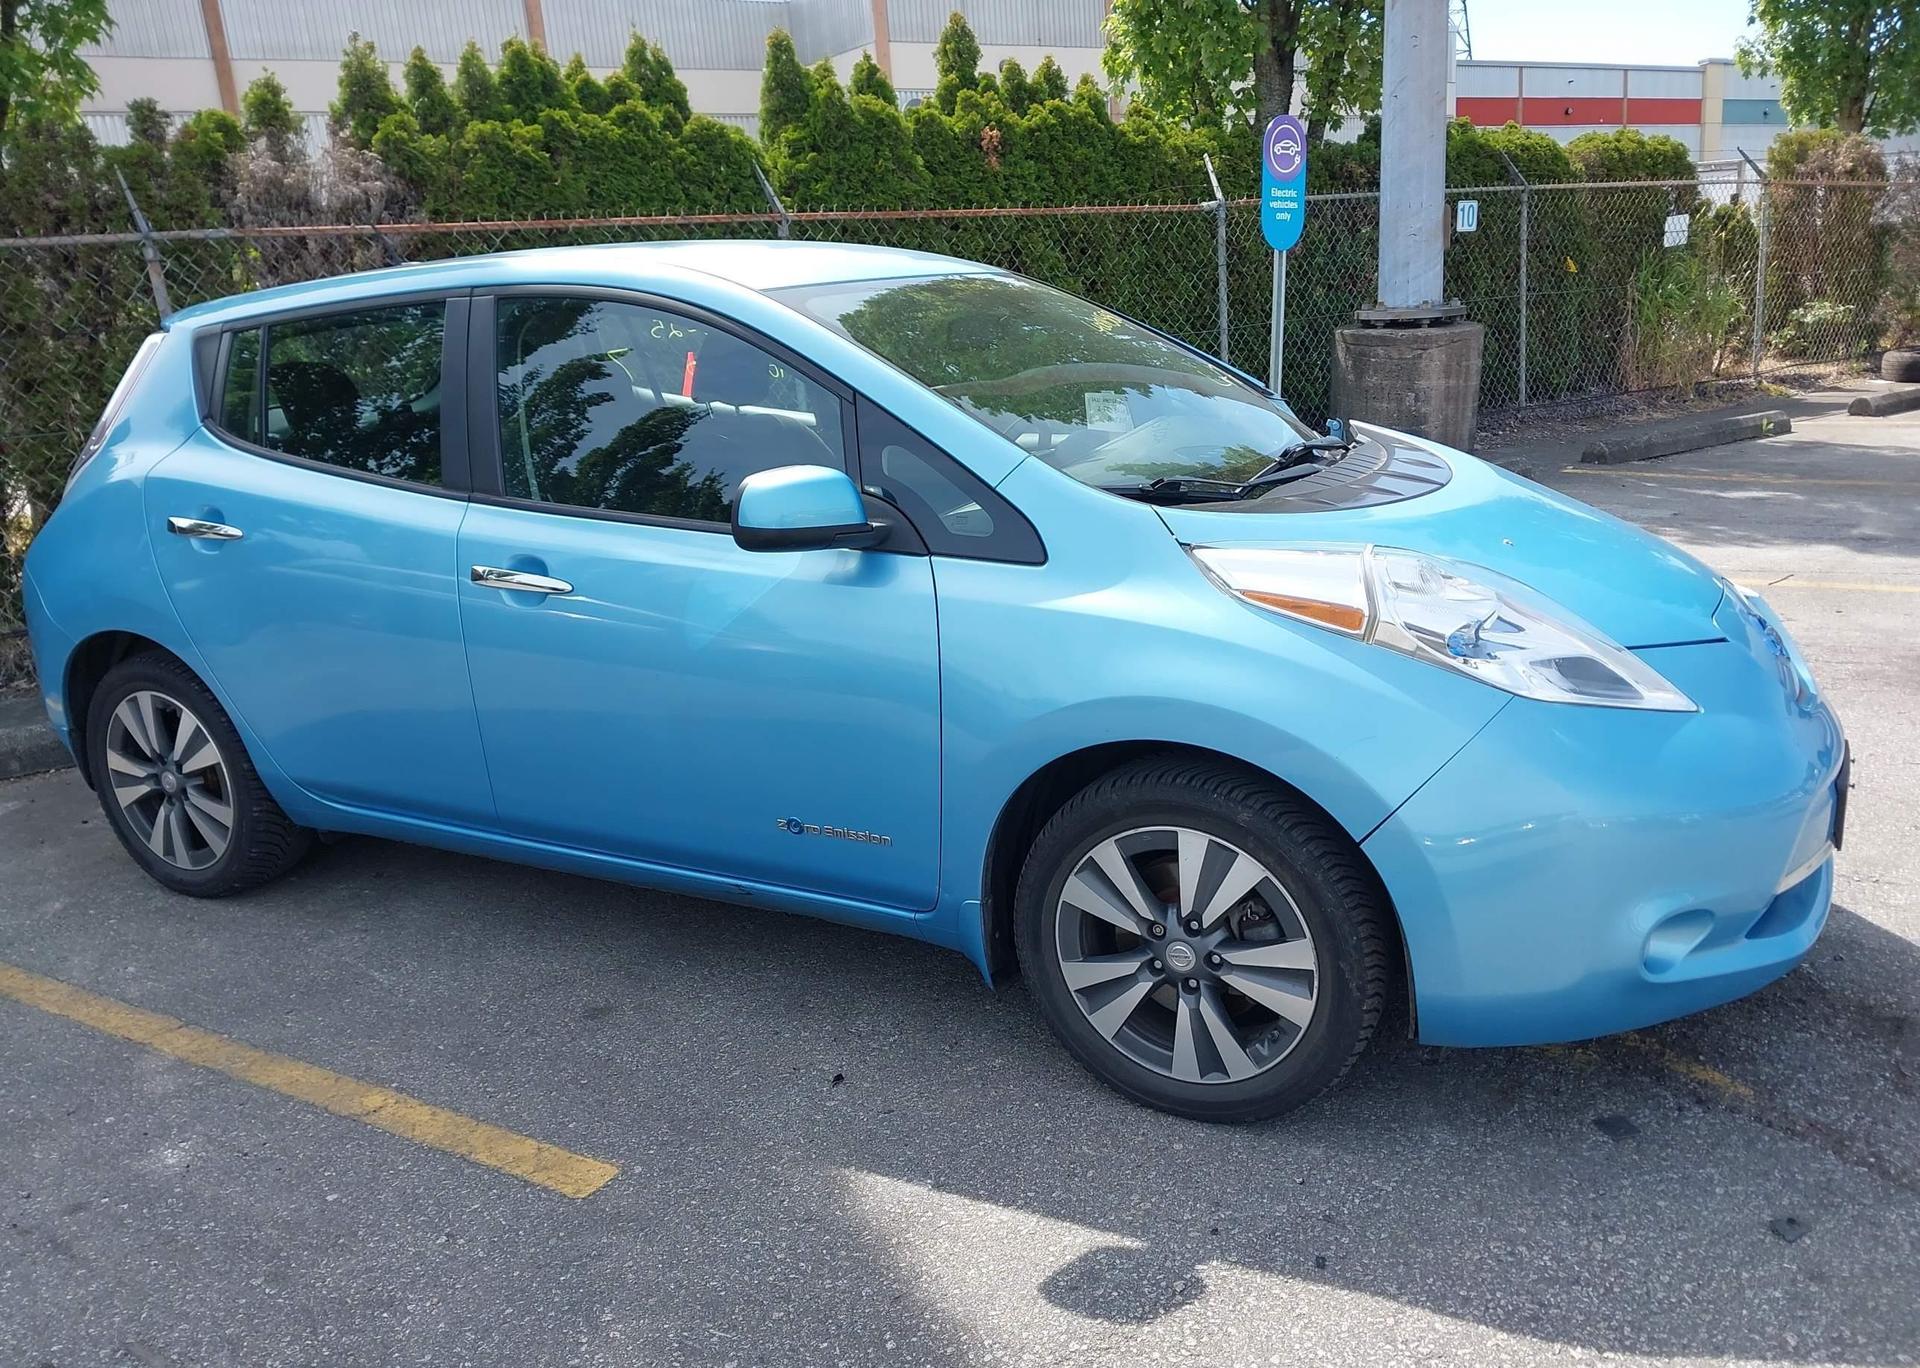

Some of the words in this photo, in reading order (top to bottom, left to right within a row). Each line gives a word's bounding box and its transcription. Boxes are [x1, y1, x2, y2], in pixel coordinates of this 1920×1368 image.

[1271, 187, 1298, 198] Electric
[1269, 199, 1299, 209] vehicles
[1275, 210, 1292, 222] only
[1459, 203, 1475, 228] 10
